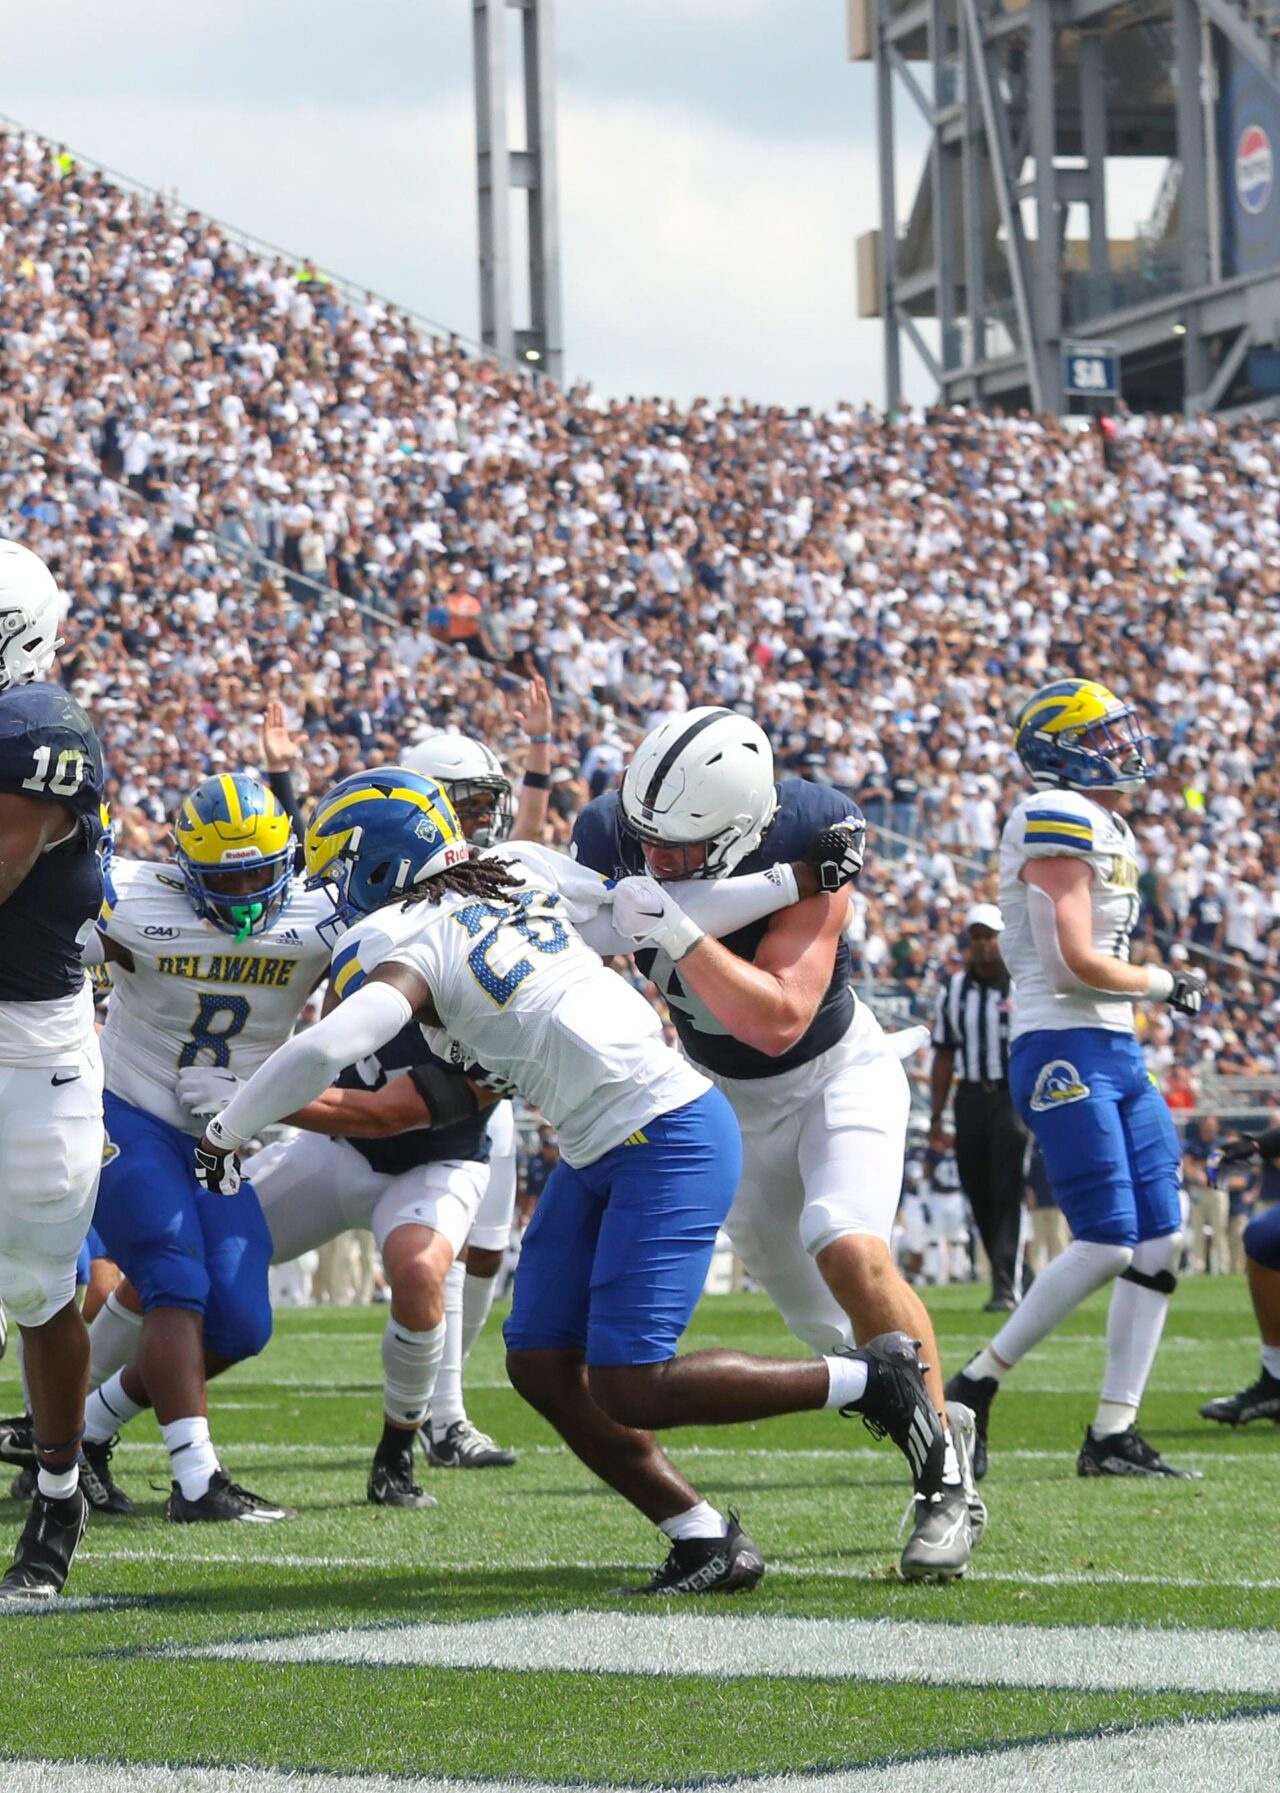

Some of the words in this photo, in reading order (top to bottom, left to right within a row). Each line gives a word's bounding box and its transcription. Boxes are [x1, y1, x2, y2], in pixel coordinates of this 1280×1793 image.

[22, 745, 84, 797] 10
[225, 850, 257, 860] Riddell
[144, 926, 173, 937] CAA
[276, 938, 304, 946] adidas
[155, 954, 299, 987] DELAWARE
[178, 991, 252, 1069] 8
